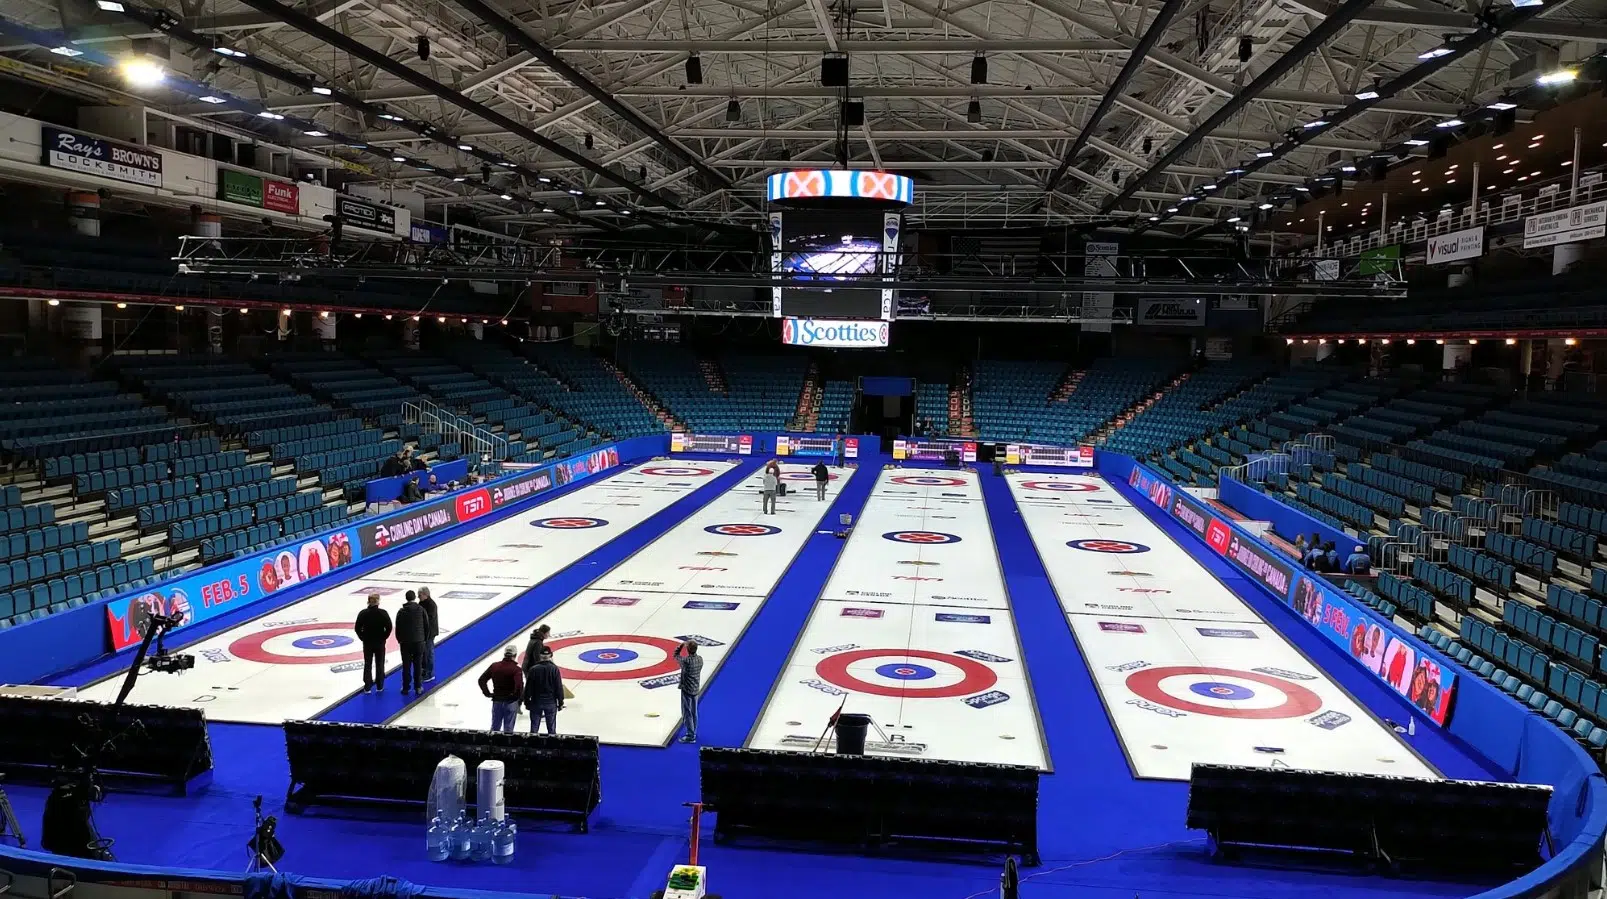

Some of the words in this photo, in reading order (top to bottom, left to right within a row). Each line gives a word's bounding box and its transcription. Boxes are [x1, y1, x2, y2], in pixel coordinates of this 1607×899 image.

[58, 133, 102, 157] Ray's
[112, 147, 160, 170] BROWN'S
[56, 152, 157, 180] LOCKSMITH
[268, 183, 292, 199] Funk
[343, 204, 375, 217] PROTEX
[1438, 237, 1459, 255] visual
[801, 320, 877, 344] Scotties
[463, 496, 484, 515] TSN
[389, 519, 414, 542] CURLING
[412, 516, 424, 534] DAY
[427, 508, 447, 529] CANADA
[1211, 526, 1226, 547] TSN
[201, 580, 238, 608] FEB.
[239, 573, 249, 596] 5
[1322, 603, 1331, 624] 5
